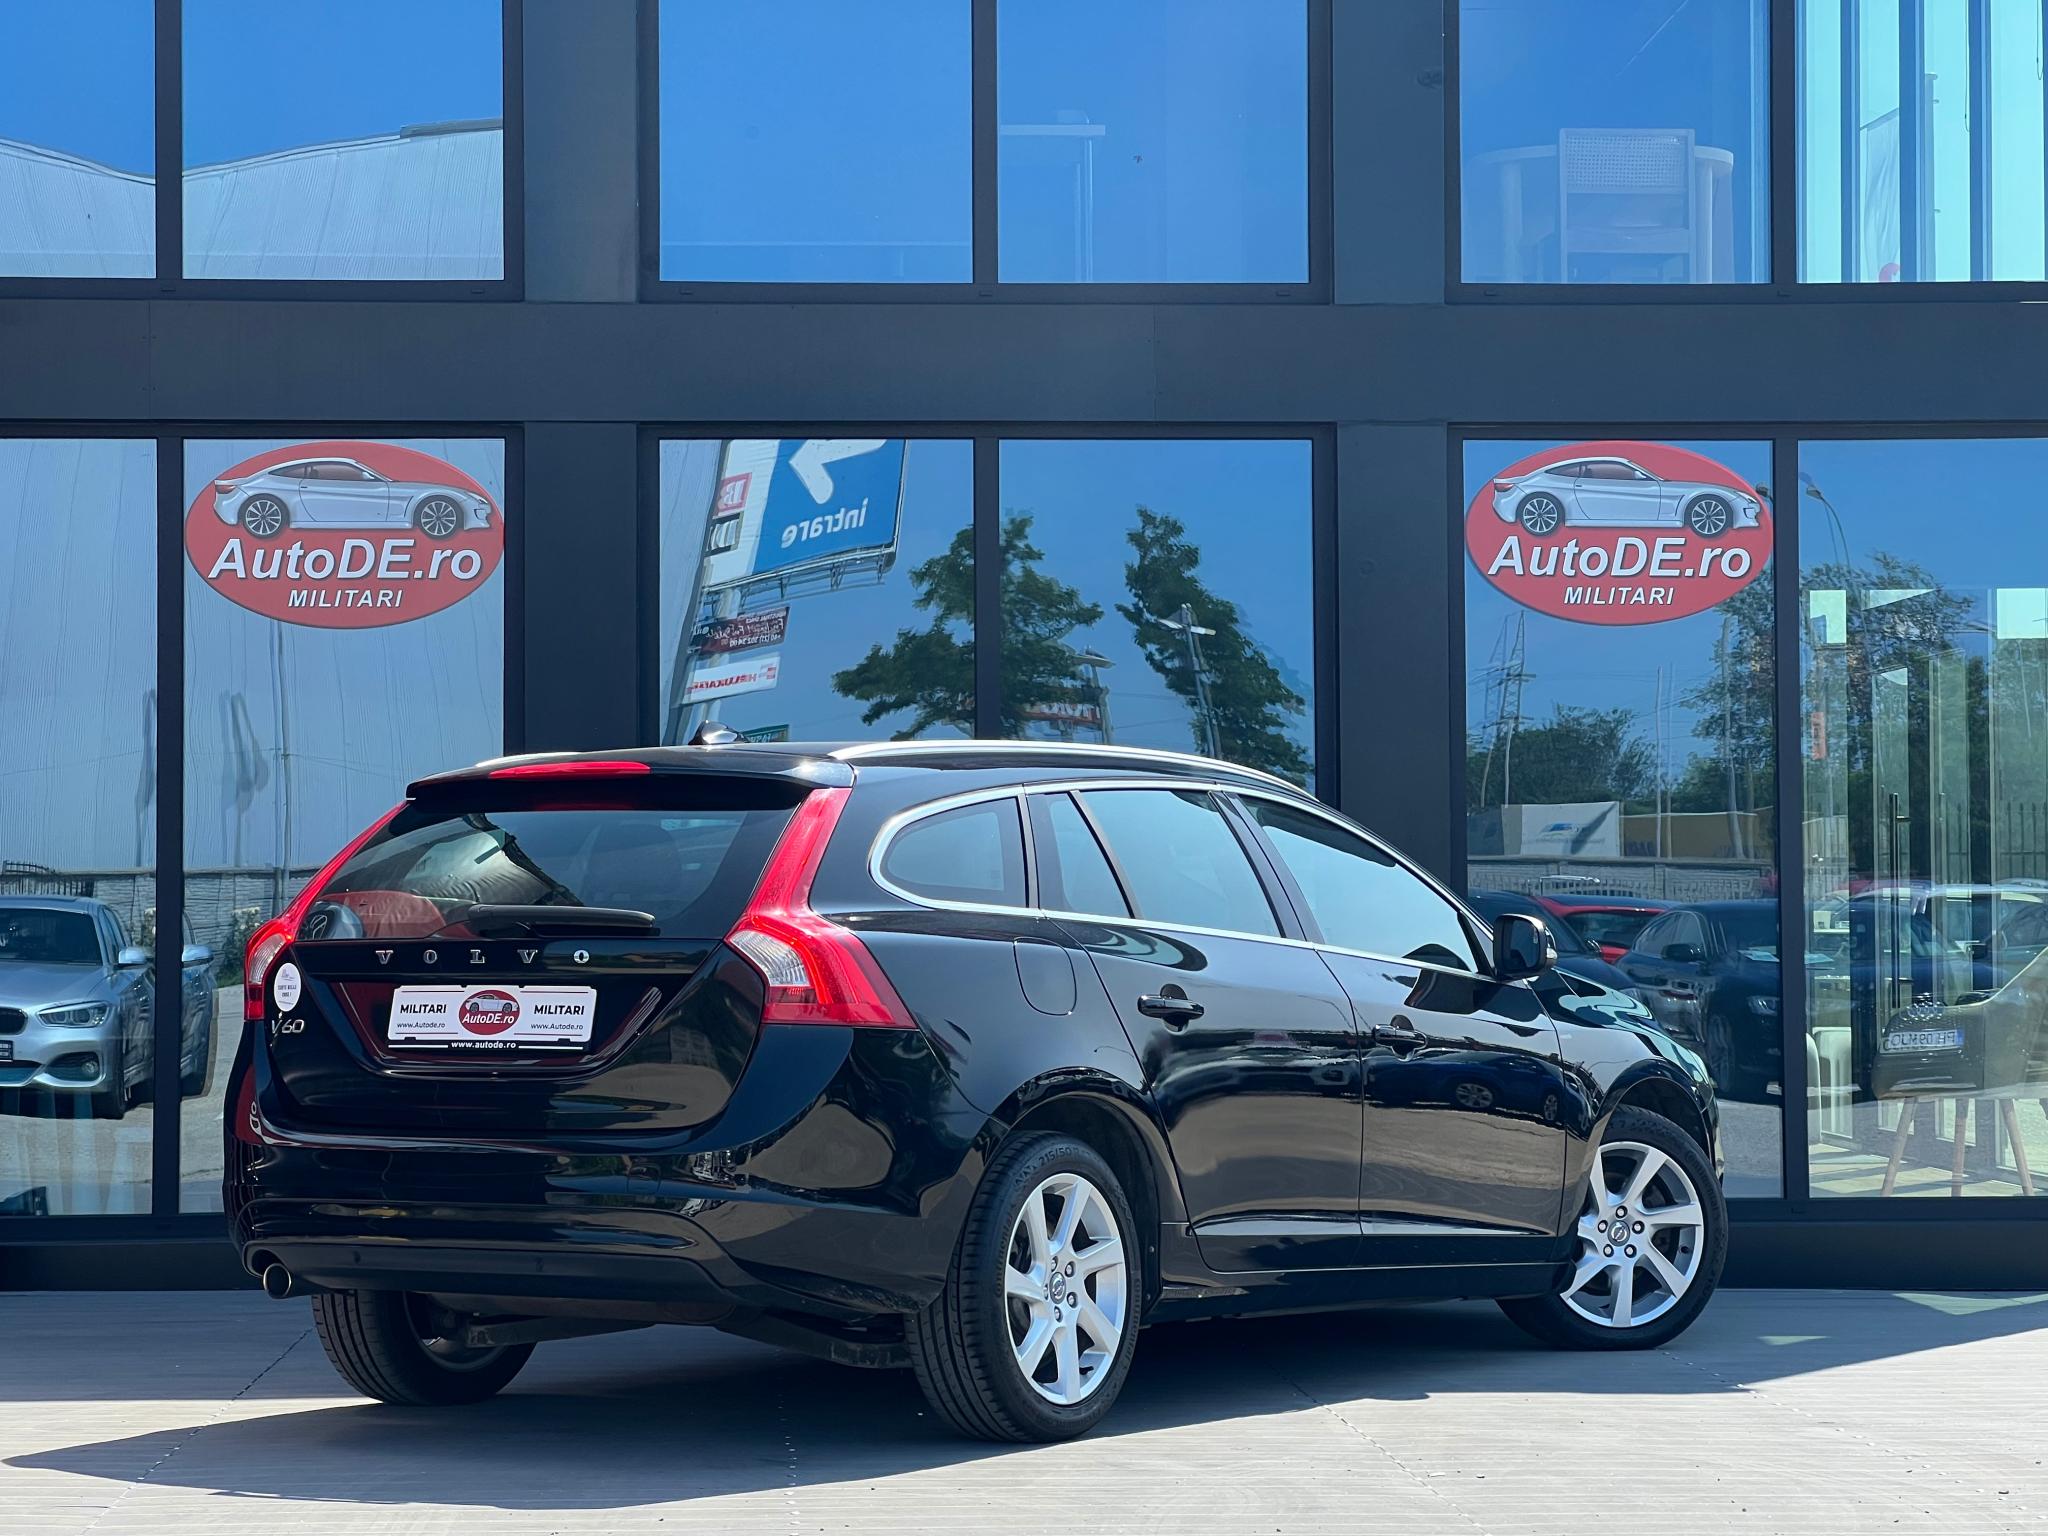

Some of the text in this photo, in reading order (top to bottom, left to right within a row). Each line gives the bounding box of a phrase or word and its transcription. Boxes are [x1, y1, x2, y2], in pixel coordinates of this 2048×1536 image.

[207, 538, 483, 580] AutoDE.ro
[1487, 535, 1752, 578] AutoDE.ro
[287, 589, 403, 608] MILITARI
[1563, 586, 1674, 606] MILITARI
[375, 949, 590, 965] VOLVO
[400, 1004, 447, 1014] MILITARI
[534, 1005, 585, 1015] MILITARI
[462, 1012, 515, 1024] AutoDE.ro
[271, 1019, 305, 1034] V60
[451, 1041, 517, 1049] www.autode.ro
